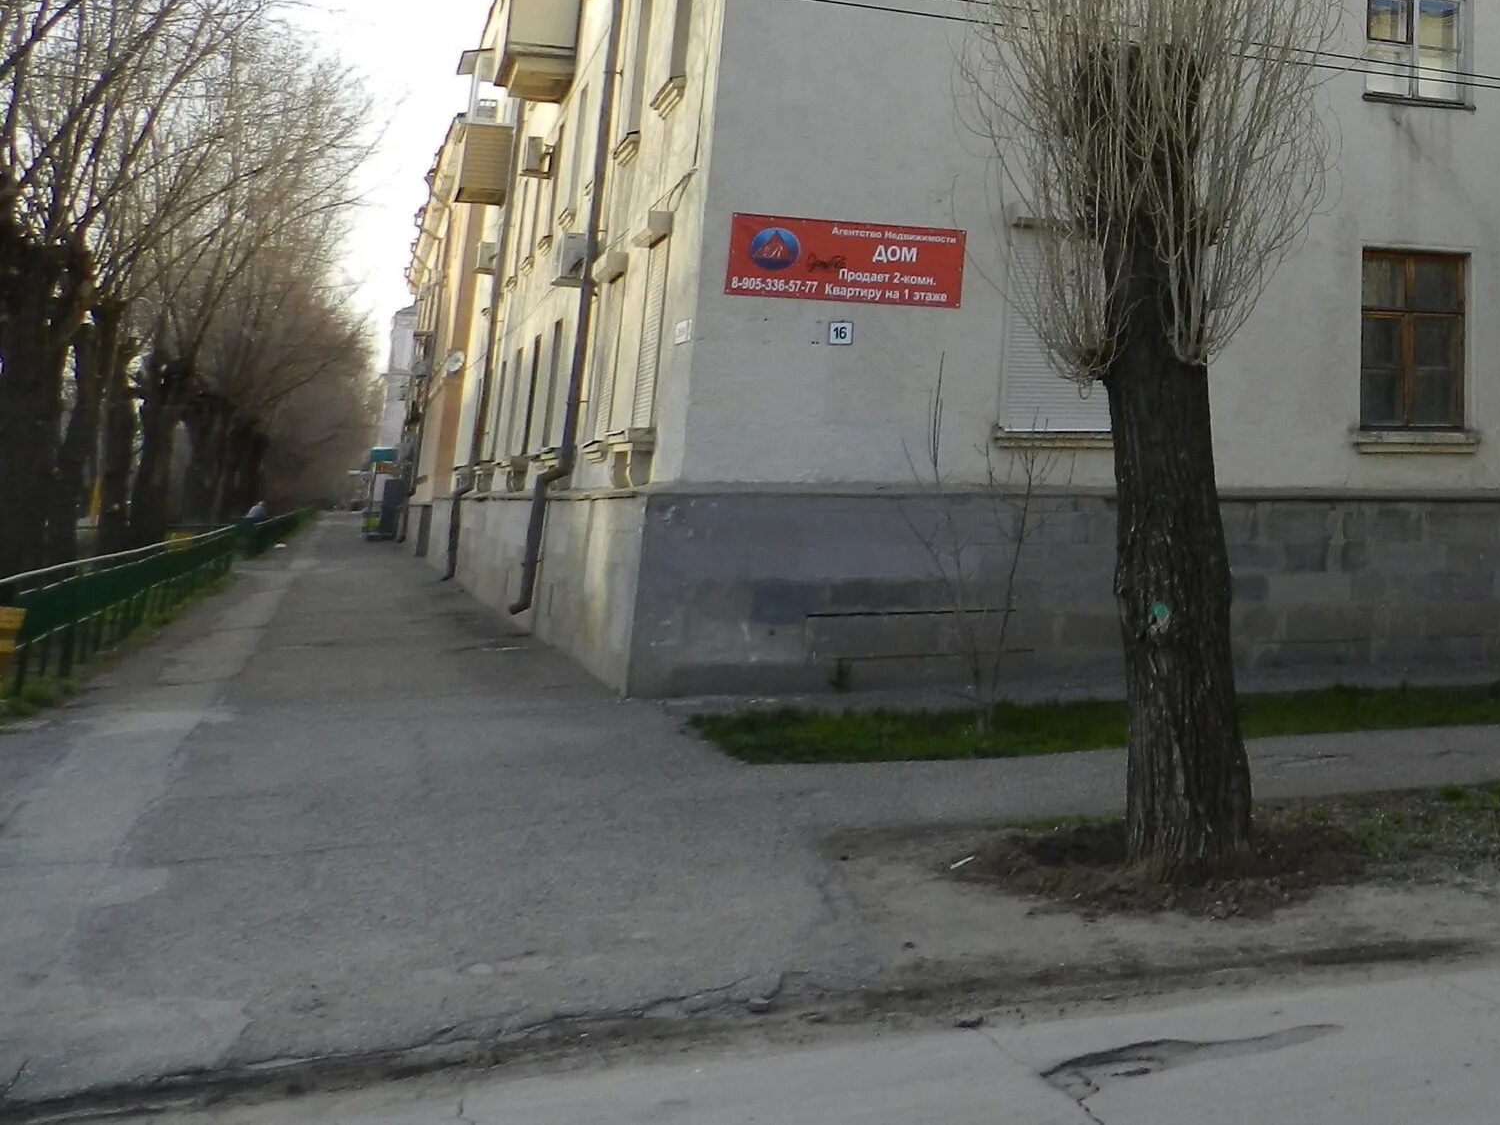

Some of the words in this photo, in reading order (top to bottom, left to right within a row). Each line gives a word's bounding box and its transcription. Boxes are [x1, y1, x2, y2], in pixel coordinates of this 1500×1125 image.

[832, 226, 882, 239] Агентство
[884, 231, 957, 244] Недвижимости
[872, 244, 918, 263] ДОМ
[731, 276, 818, 293] 8-905-336-57-77
[838, 268, 890, 284] Продает
[893, 272, 937, 286] 2-комн.
[825, 283, 882, 300] Квартиру
[885, 290, 900, 300] на
[903, 288, 910, 300] 1
[913, 291, 948, 303] этаже
[833, 326, 848, 340] 16
